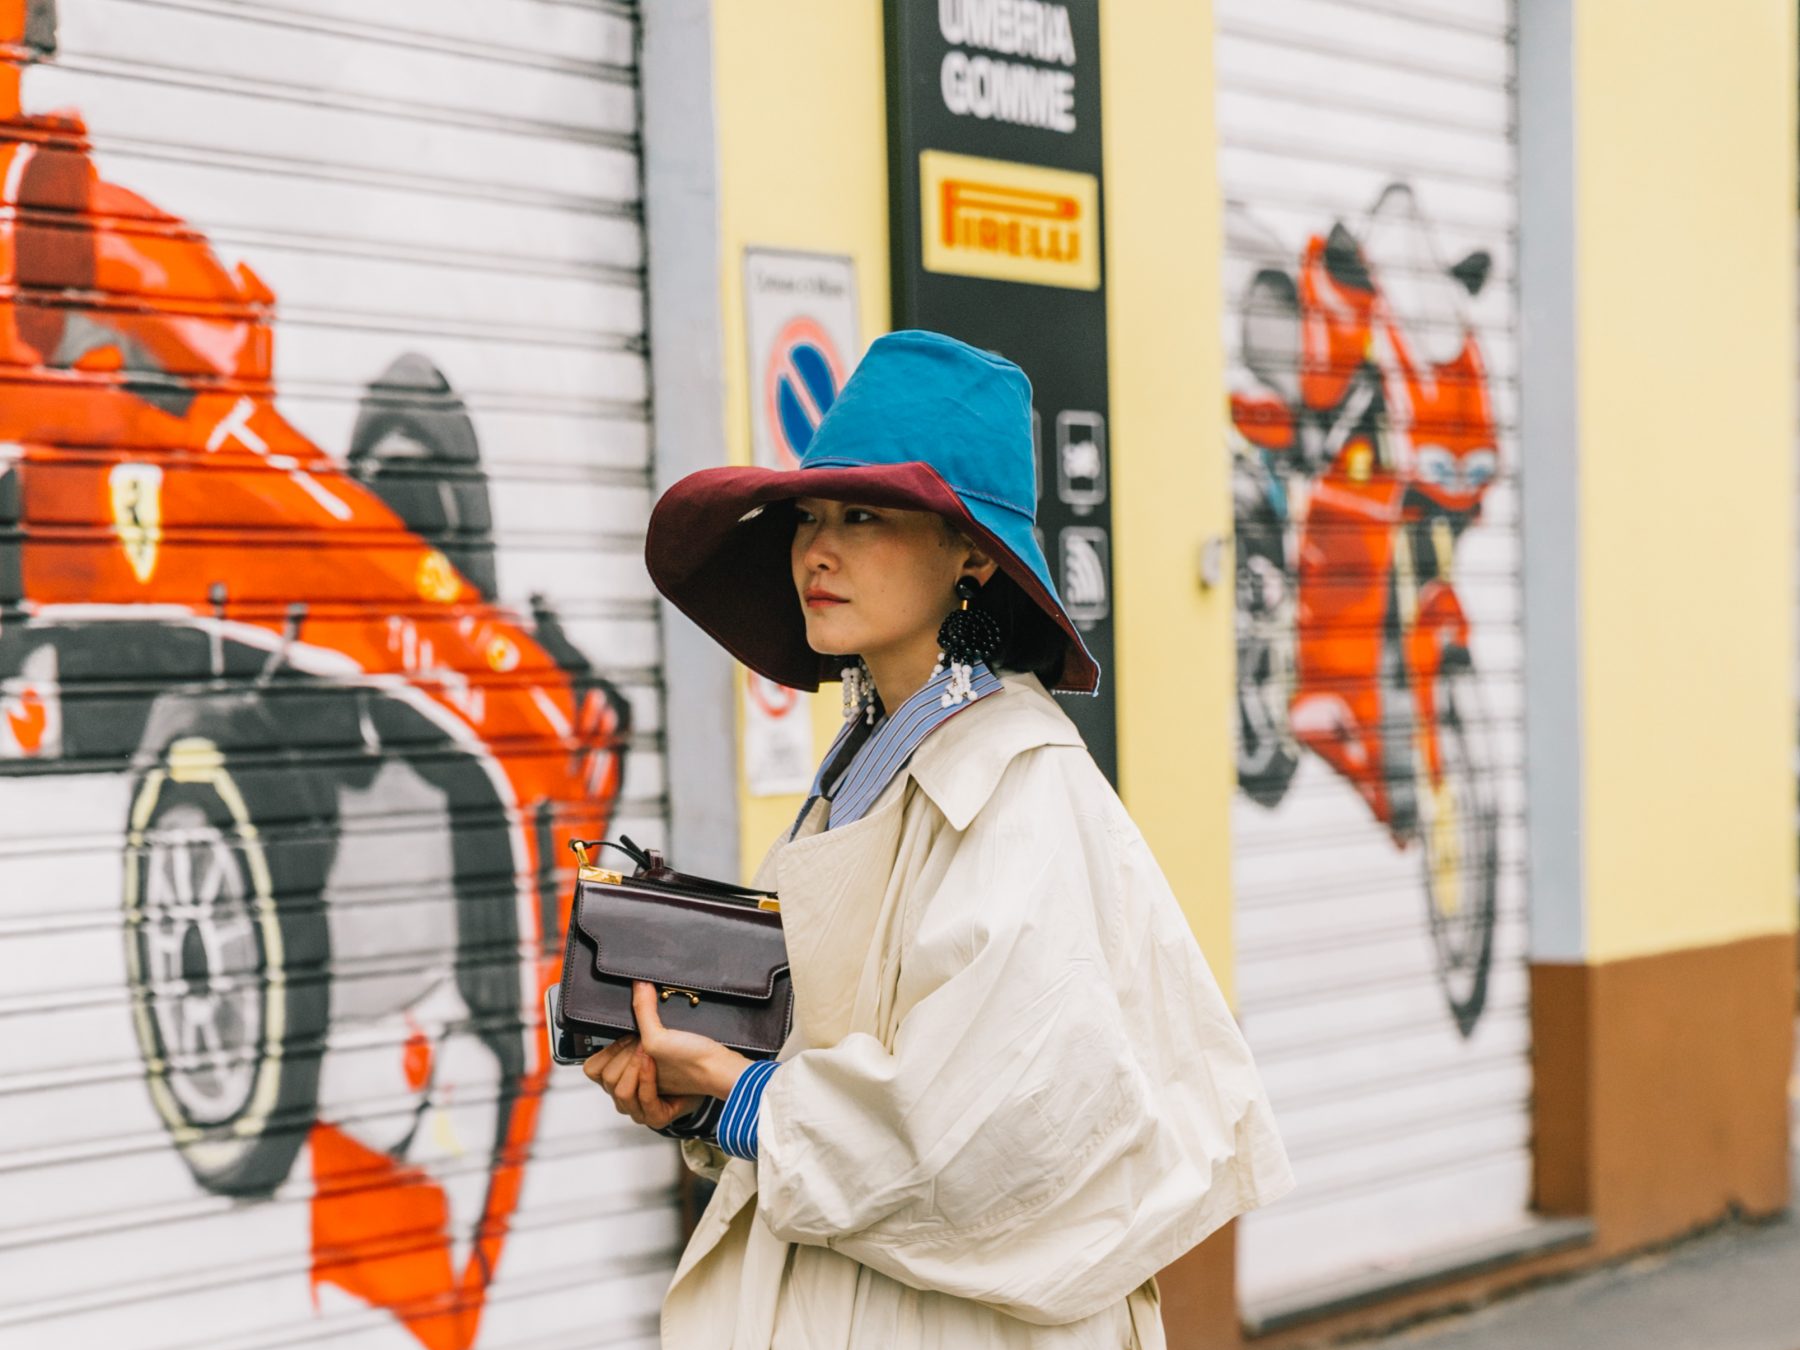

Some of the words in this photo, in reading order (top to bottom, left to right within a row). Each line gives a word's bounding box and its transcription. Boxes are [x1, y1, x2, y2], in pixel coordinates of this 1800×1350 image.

[938, 0, 1076, 67] UMBRIA
[940, 50, 1077, 133] GOMME
[940, 178, 1081, 264] PIRELLI
